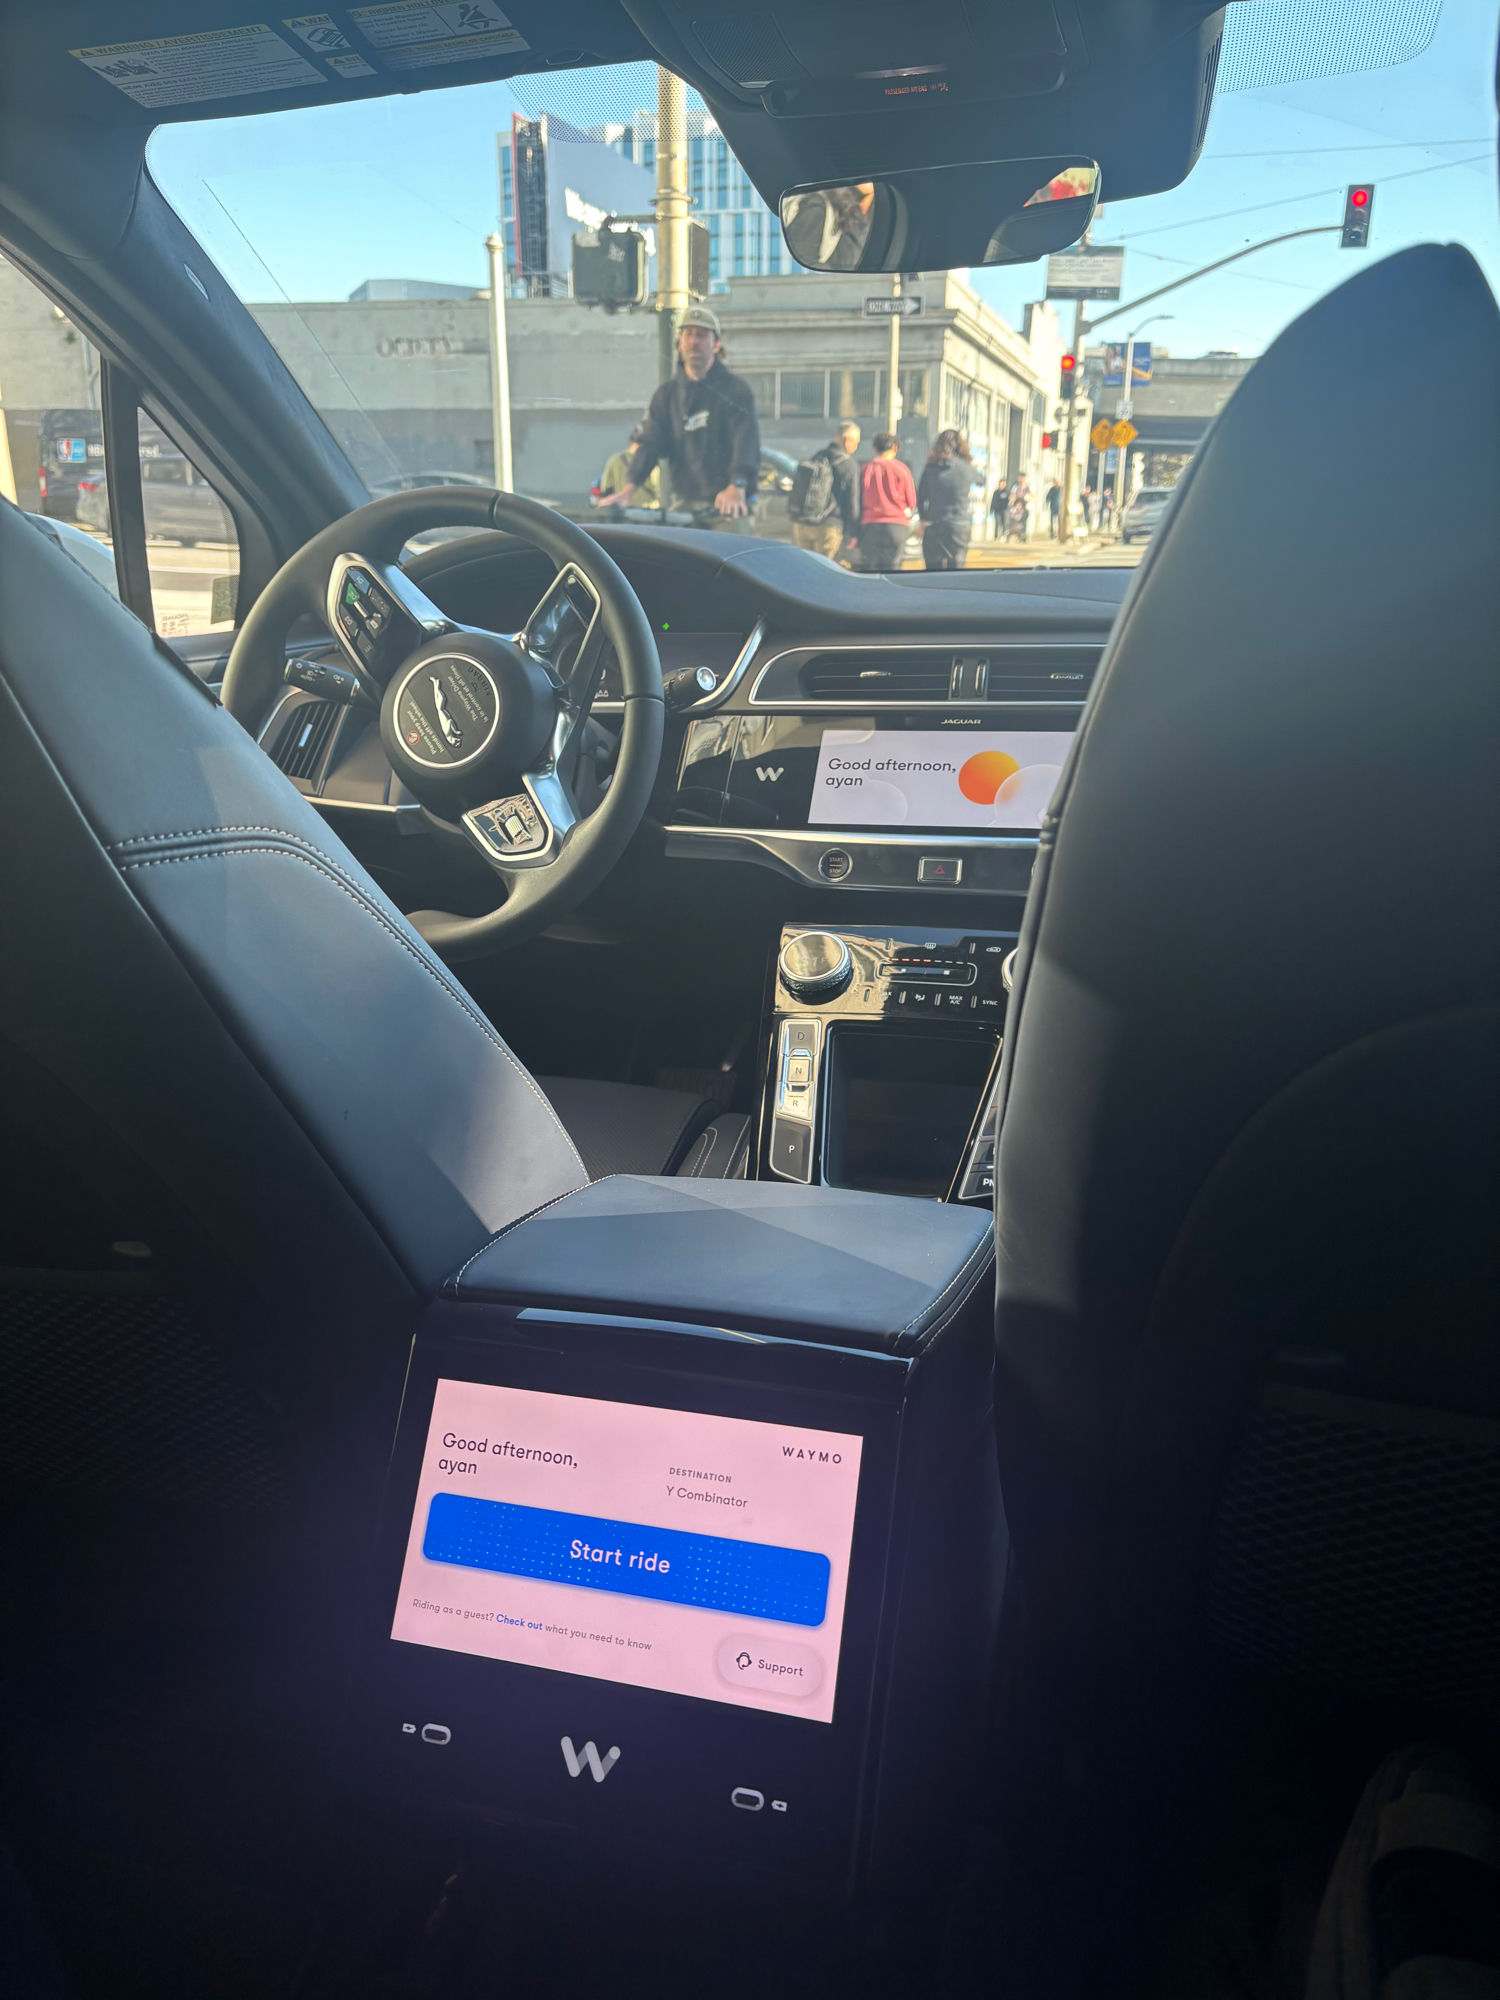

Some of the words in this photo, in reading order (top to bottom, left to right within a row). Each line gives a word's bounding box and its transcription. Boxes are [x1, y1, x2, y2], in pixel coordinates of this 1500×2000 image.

[96, 42, 154, 54] WARNING
[828, 758, 871, 771] Good
[875, 759, 957, 774] afternoon,
[825, 776, 863, 789] ayan
[797, 1031, 805, 1041] D
[795, 1067, 803, 1075] N
[792, 1099, 799, 1107] R
[788, 1144, 796, 1153] P
[442, 1432, 489, 1453] Good
[492, 1441, 578, 1469] afternoon,
[781, 1446, 842, 1464] WAYMO
[438, 1458, 478, 1475] ayan
[669, 1467, 732, 1484] DESTINATION
[666, 1485, 675, 1496] Y
[677, 1487, 749, 1508] Combinator
[569, 1539, 623, 1566] Start
[628, 1551, 671, 1574] ride
[412, 1598, 441, 1614] Riding
[442, 1605, 454, 1614] as
[463, 1610, 495, 1622] guest?
[496, 1613, 525, 1627] Check
[527, 1620, 543, 1631] out
[545, 1623, 569, 1635] what
[570, 1628, 587, 1639] you
[589, 1632, 613, 1643] need
[615, 1636, 625, 1646] to
[627, 1638, 653, 1651] know
[757, 1658, 804, 1677] Support
